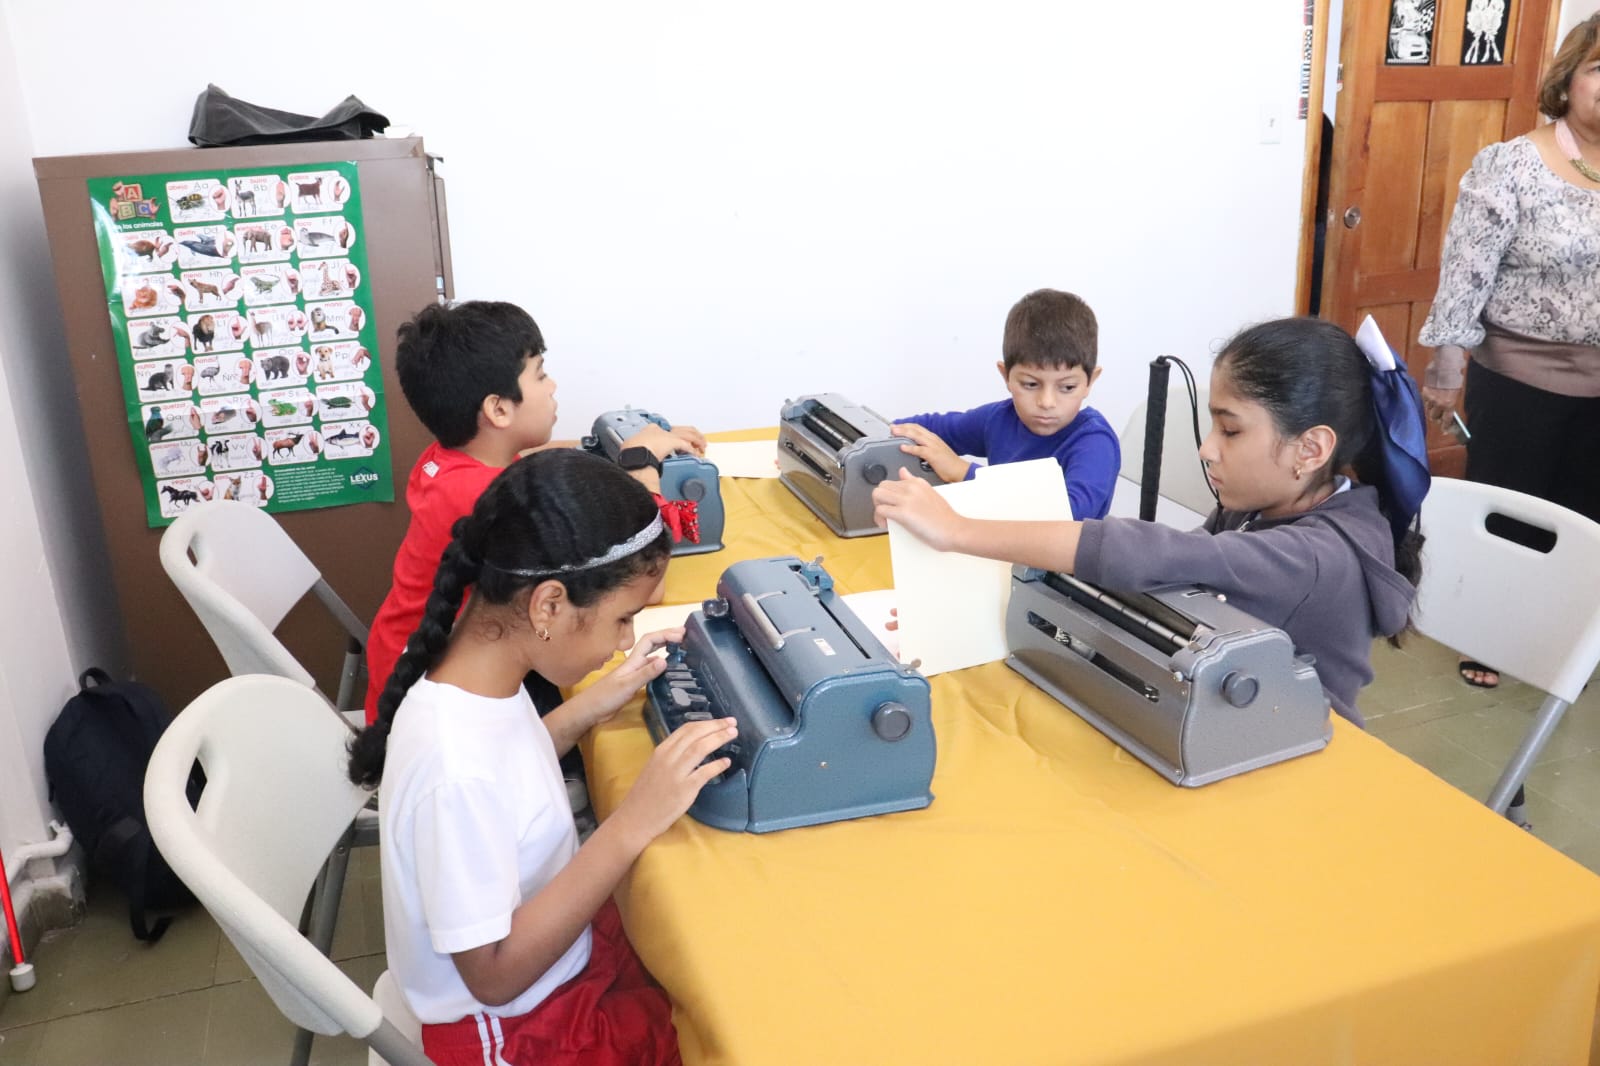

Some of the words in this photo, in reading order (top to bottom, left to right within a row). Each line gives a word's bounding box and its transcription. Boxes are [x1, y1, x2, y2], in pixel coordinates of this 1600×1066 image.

[128, 188, 136, 197] A
[122, 204, 132, 216] B
[140, 204, 149, 213] C
[350, 473, 379, 483] LEXUS
